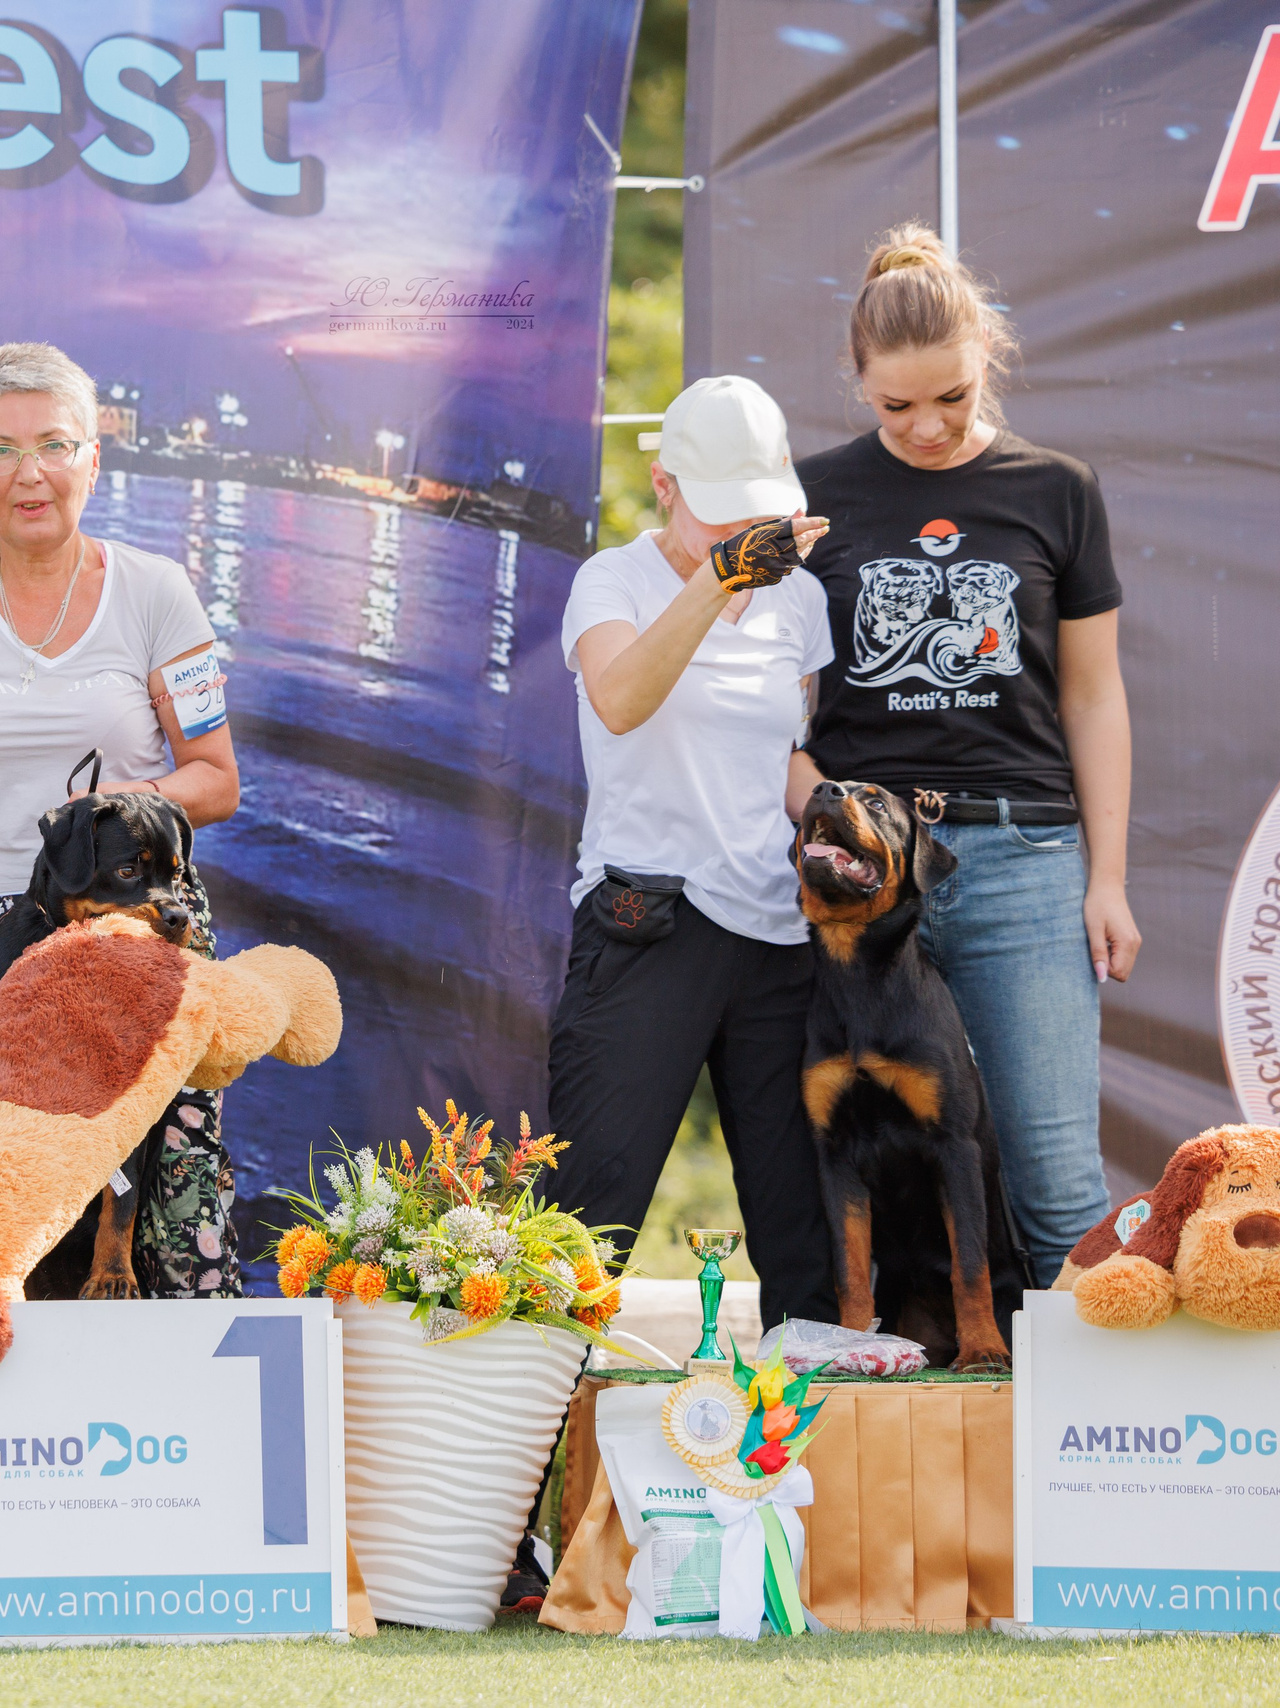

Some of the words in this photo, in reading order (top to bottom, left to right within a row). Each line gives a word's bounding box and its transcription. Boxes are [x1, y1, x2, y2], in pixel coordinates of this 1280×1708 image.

[888, 690, 950, 711] Rotti's
[955, 689, 1000, 708] Rest
[212, 1315, 308, 1546] 1
[1059, 1454, 1102, 1463] КОРМА
[1108, 1455, 1133, 1464] ДЛЯ
[1140, 1456, 1182, 1465] СОБАК
[4, 1469, 31, 1479] ДЛЯ
[39, 1468, 84, 1478] СОБАК
[645, 1486, 707, 1500] AMINO
[1049, 1482, 1096, 1494] ЛУЧШЕЕ,
[1098, 1483, 1119, 1493] ЧТО
[1121, 1483, 1148, 1494] ЕСТЬ
[1149, 1484, 1157, 1494] У
[1159, 1484, 1214, 1495] ЧЕЛОВЕКА
[1224, 1485, 1245, 1496] ЭТО
[18, 1500, 47, 1511] ЕСТЬ
[48, 1500, 56, 1510] У
[59, 1499, 119, 1510] ЧЕЛОВЕКА
[130, 1498, 153, 1509] ЭТО
[155, 1497, 201, 1508] СОБАКА
[1057, 1575, 1280, 1612] www.amin
